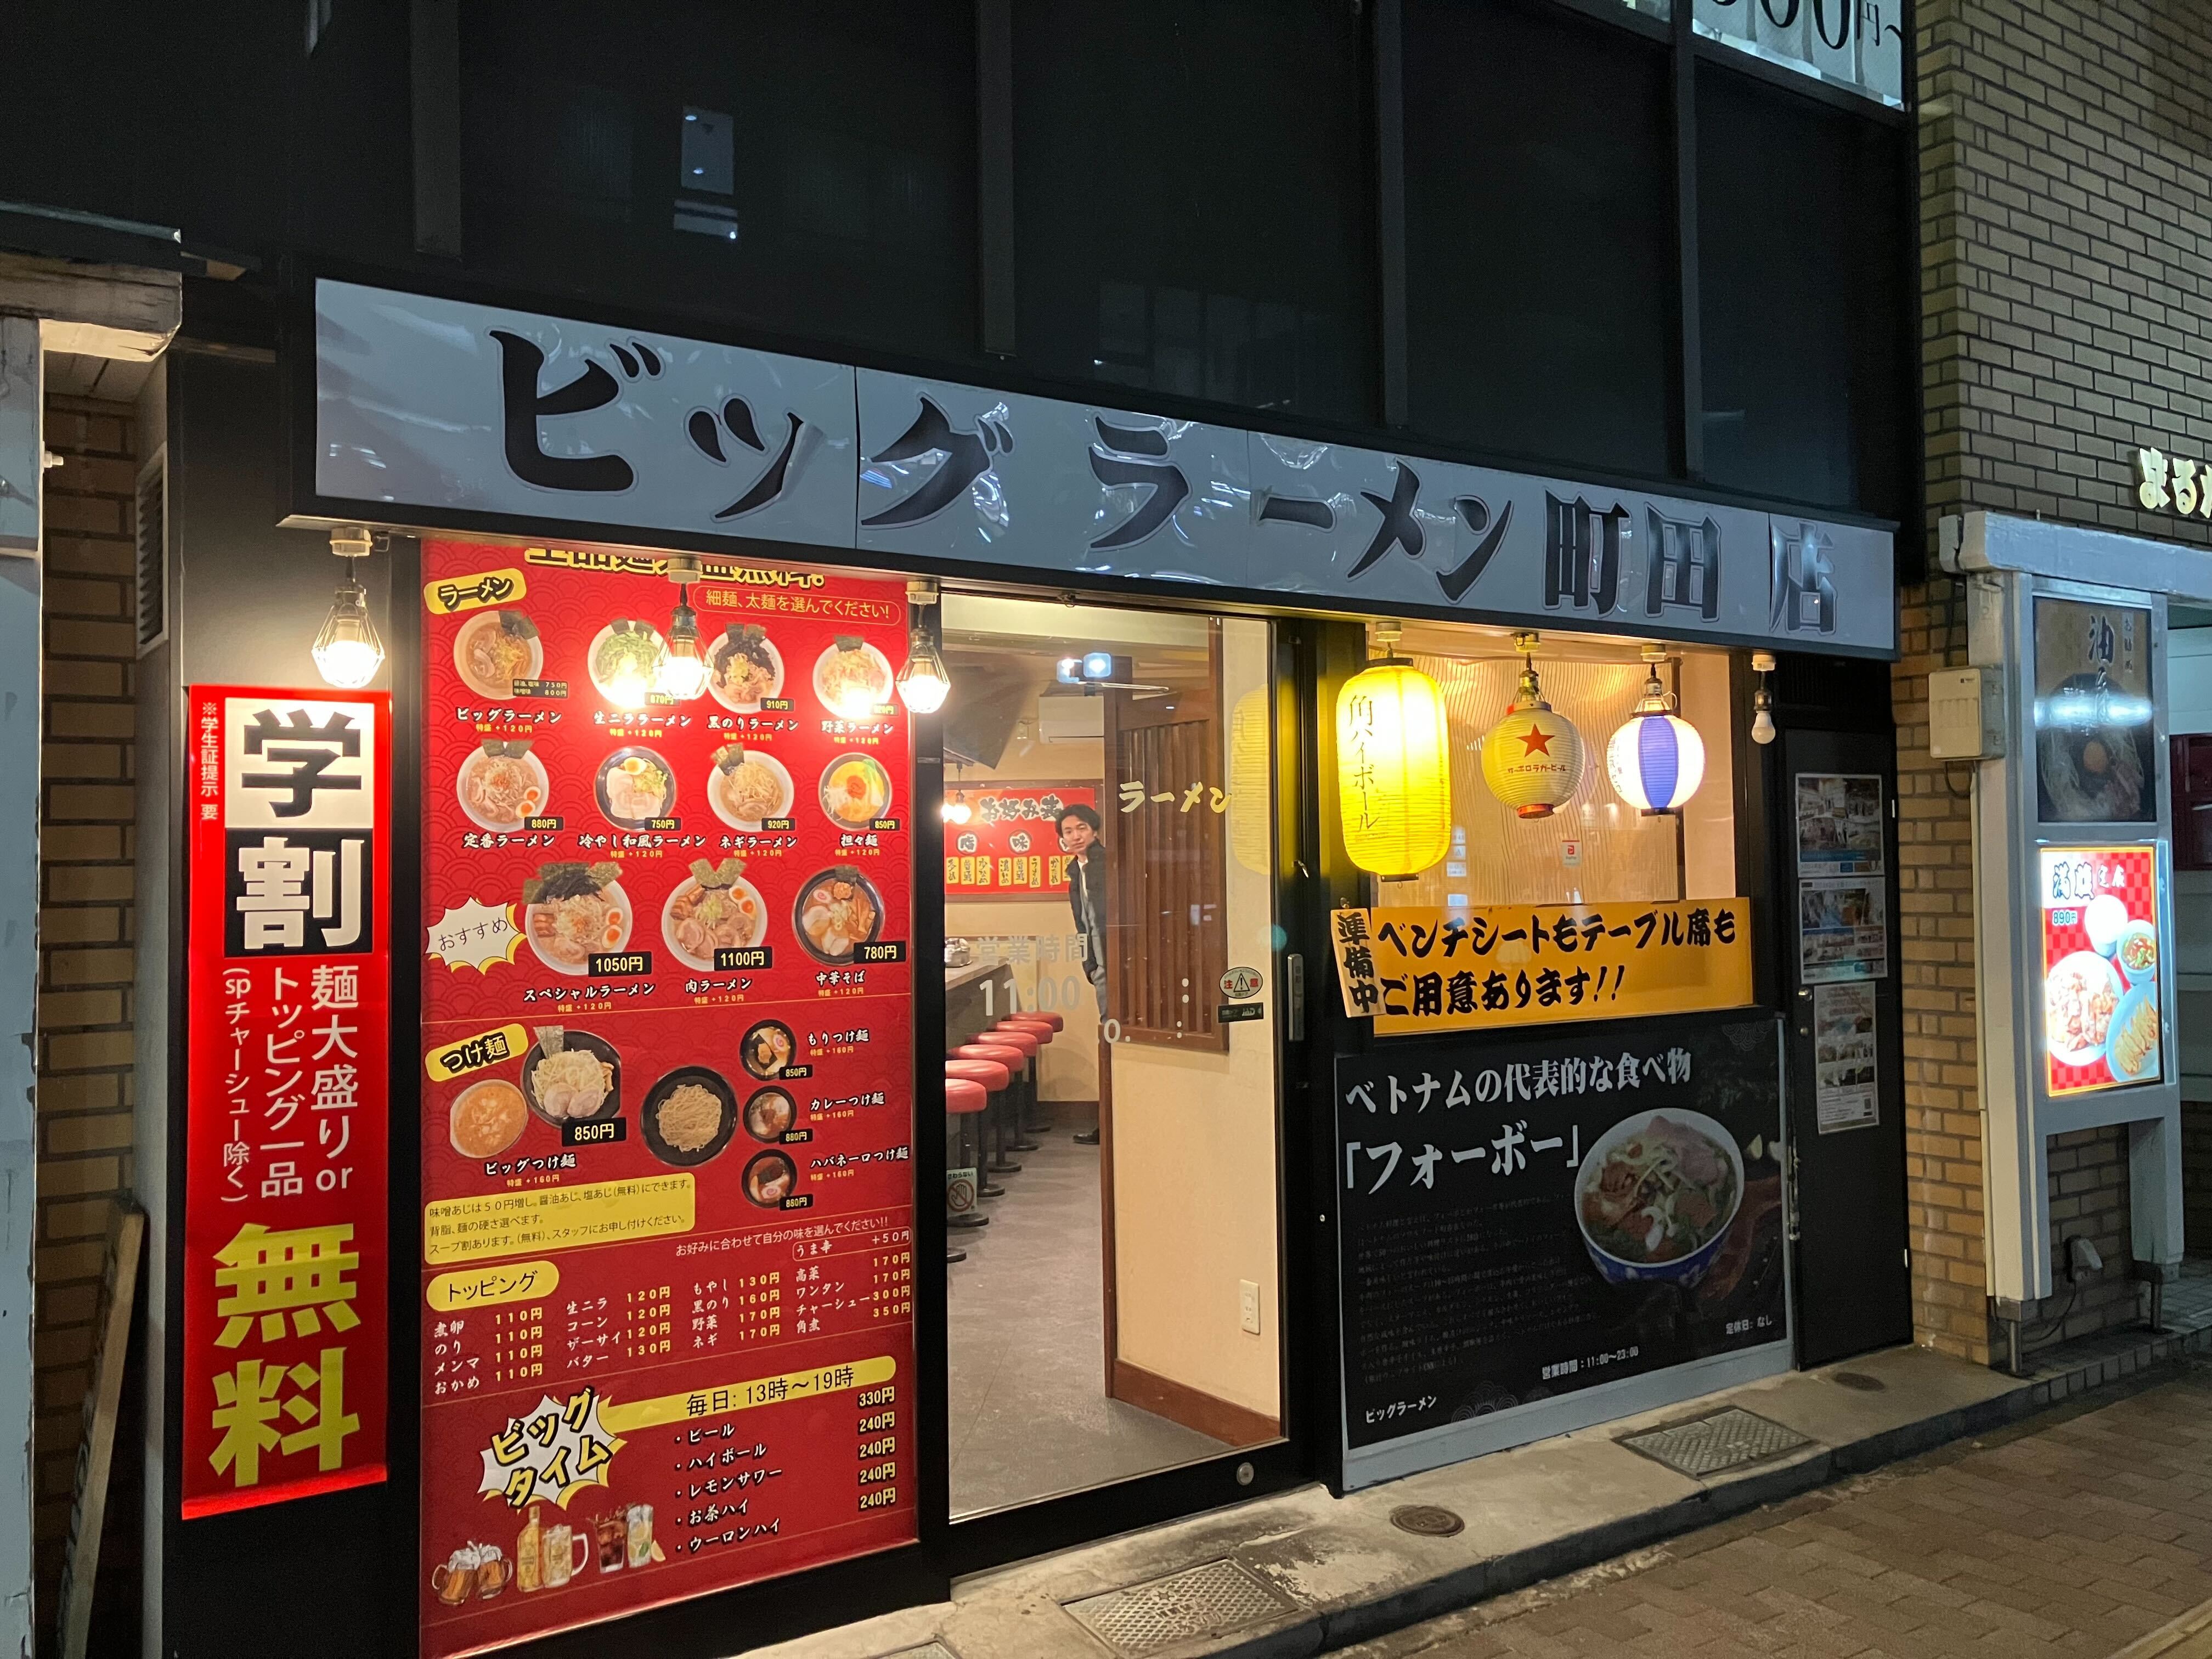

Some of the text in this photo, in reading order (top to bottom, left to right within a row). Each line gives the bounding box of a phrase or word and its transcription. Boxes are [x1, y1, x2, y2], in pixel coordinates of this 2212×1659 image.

[438, 576, 514, 612] ラーメン
[455, 707, 562, 724] ビッグラーメン
[766, 701, 789, 710] 910円
[593, 710, 692, 727] 生ニララーメン
[707, 715, 799, 731] 黒のりラーメン
[821, 720, 894, 735] 野菜ラーメン
[1349, 695, 1380, 832] 角ハイボール
[1119, 780, 1232, 814] ラーメン
[200, 804, 218, 820] 要
[236, 709, 364, 950] 学割
[531, 819, 557, 829] 880円
[651, 820, 675, 829] 750円
[768, 820, 789, 830] 920円
[874, 820, 895, 830] 850円
[462, 833, 555, 849] 定番ラーメン
[578, 834, 707, 848] 冷やし和風ラーメン
[719, 835, 798, 849] ネギラーメン
[839, 834, 878, 848] 担々麺
[438, 917, 509, 951] おすすめ
[1378, 907, 1736, 958] ベンチシートもテーブル席も
[720, 951, 765, 967] 1100円
[864, 945, 898, 961] 780円
[977, 933, 1088, 966] 営業時間
[595, 957, 644, 973] 1050円
[1337, 911, 1379, 1014] 準備中
[685, 977, 753, 994] 肉ラーメン
[815, 969, 866, 986] 中華そば
[523, 983, 656, 1002] スペシャルラーメン
[979, 975, 1081, 1017] 11:00
[1380, 965, 1625, 1017] ご用意あります!!
[808, 1029, 870, 1046] もりつけ麺
[440, 1032, 510, 1073] つけ麺
[260, 967, 305, 1198] トッピング一品
[785, 1068, 807, 1077] 850円
[1345, 1047, 1692, 1115] ベトナムの代表的な食べ物
[810, 1092, 885, 1111] カレーつけ麺
[574, 1123, 614, 1141] 850円
[785, 1131, 807, 1142] 880円
[484, 1153, 577, 1176] ビッグつけ麺
[810, 1147, 909, 1168] ハバネーロつけ麺
[1345, 1120, 1579, 1195] 「フォーボー」
[786, 1197, 807, 1207] 880円
[795, 1252, 910, 1283] 高菜 170円
[449, 1271, 538, 1303] トッピング
[693, 1272, 780, 1295] もやし 130円
[796, 1268, 910, 1298] ワンタン 170円
[566, 1286, 670, 1315] 生ニラ 120円
[692, 1289, 780, 1314] 黒のり 160円
[795, 1285, 910, 1316] チャーシュー 300円
[495, 1307, 543, 1325] 110円
[567, 1304, 670, 1333] コーン 120円
[692, 1306, 780, 1331] 野菜 170円
[796, 1302, 910, 1334] 角煮 350円
[435, 1326, 543, 1356] のり 110円
[567, 1322, 670, 1351] ザーサイ 120円
[693, 1323, 780, 1348] ネギ 170円
[208, 1223, 361, 1487] 無料
[435, 1345, 543, 1376] メンマ 110円
[567, 1340, 670, 1369] バター 130円
[435, 1363, 543, 1395] おかめ 110円
[859, 1386, 895, 1407] 330円
[1365, 1395, 1436, 1424] ビッグラーメン
[859, 1411, 895, 1432] 240円
[859, 1436, 896, 1458] 240円
[505, 1434, 613, 1509] タイム
[860, 1462, 896, 1483] 240円
[860, 1487, 896, 1509] 240円
